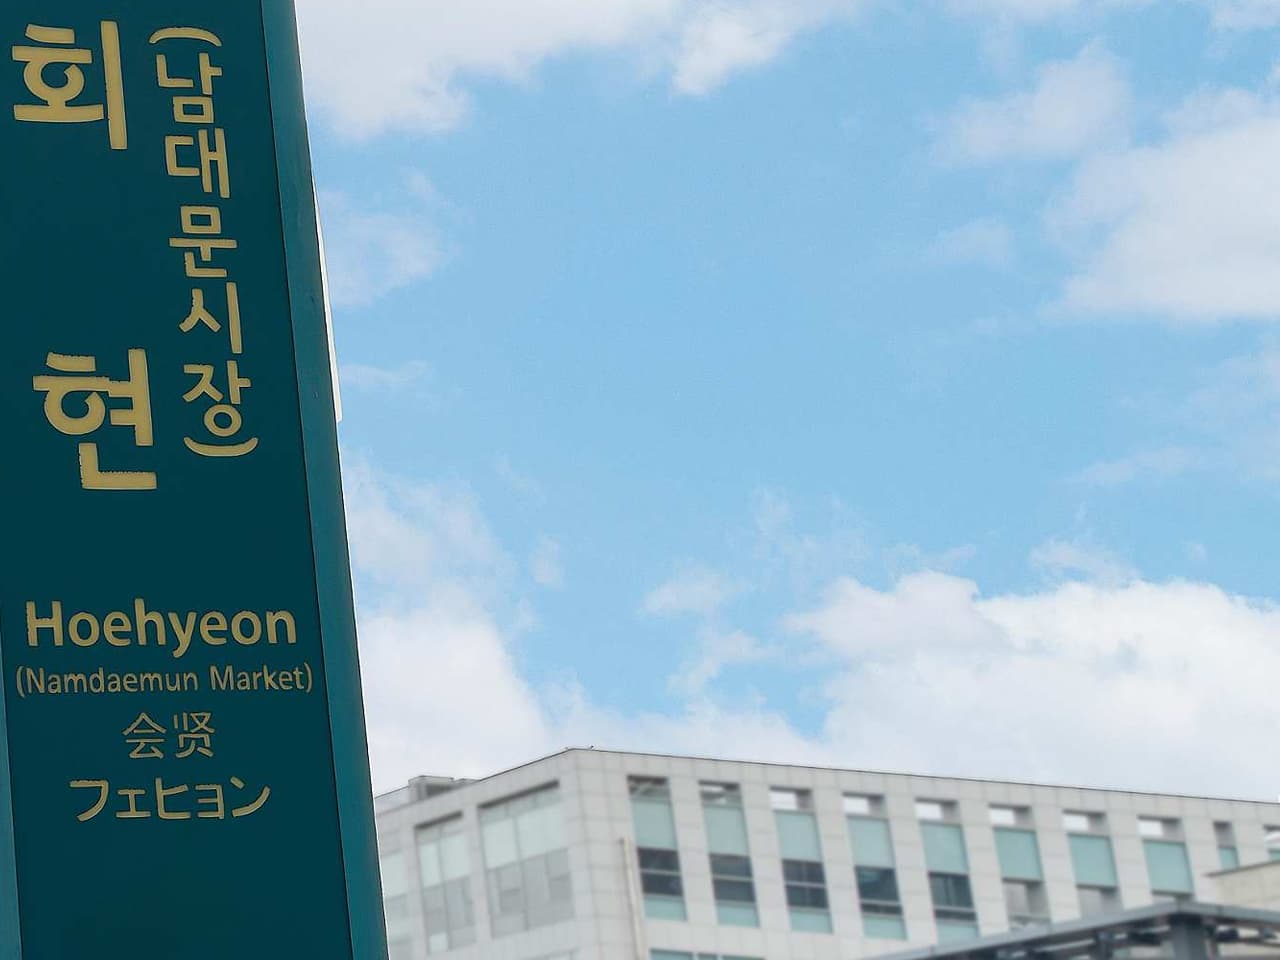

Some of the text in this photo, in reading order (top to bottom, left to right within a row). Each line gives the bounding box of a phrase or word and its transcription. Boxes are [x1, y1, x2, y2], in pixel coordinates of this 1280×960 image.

[25, 597, 298, 659] Hoehyeon
[15, 661, 314, 699] (Namdaemun Market)
[122, 711, 216, 760] 会贤
[69, 776, 272, 823] フェヒョン
